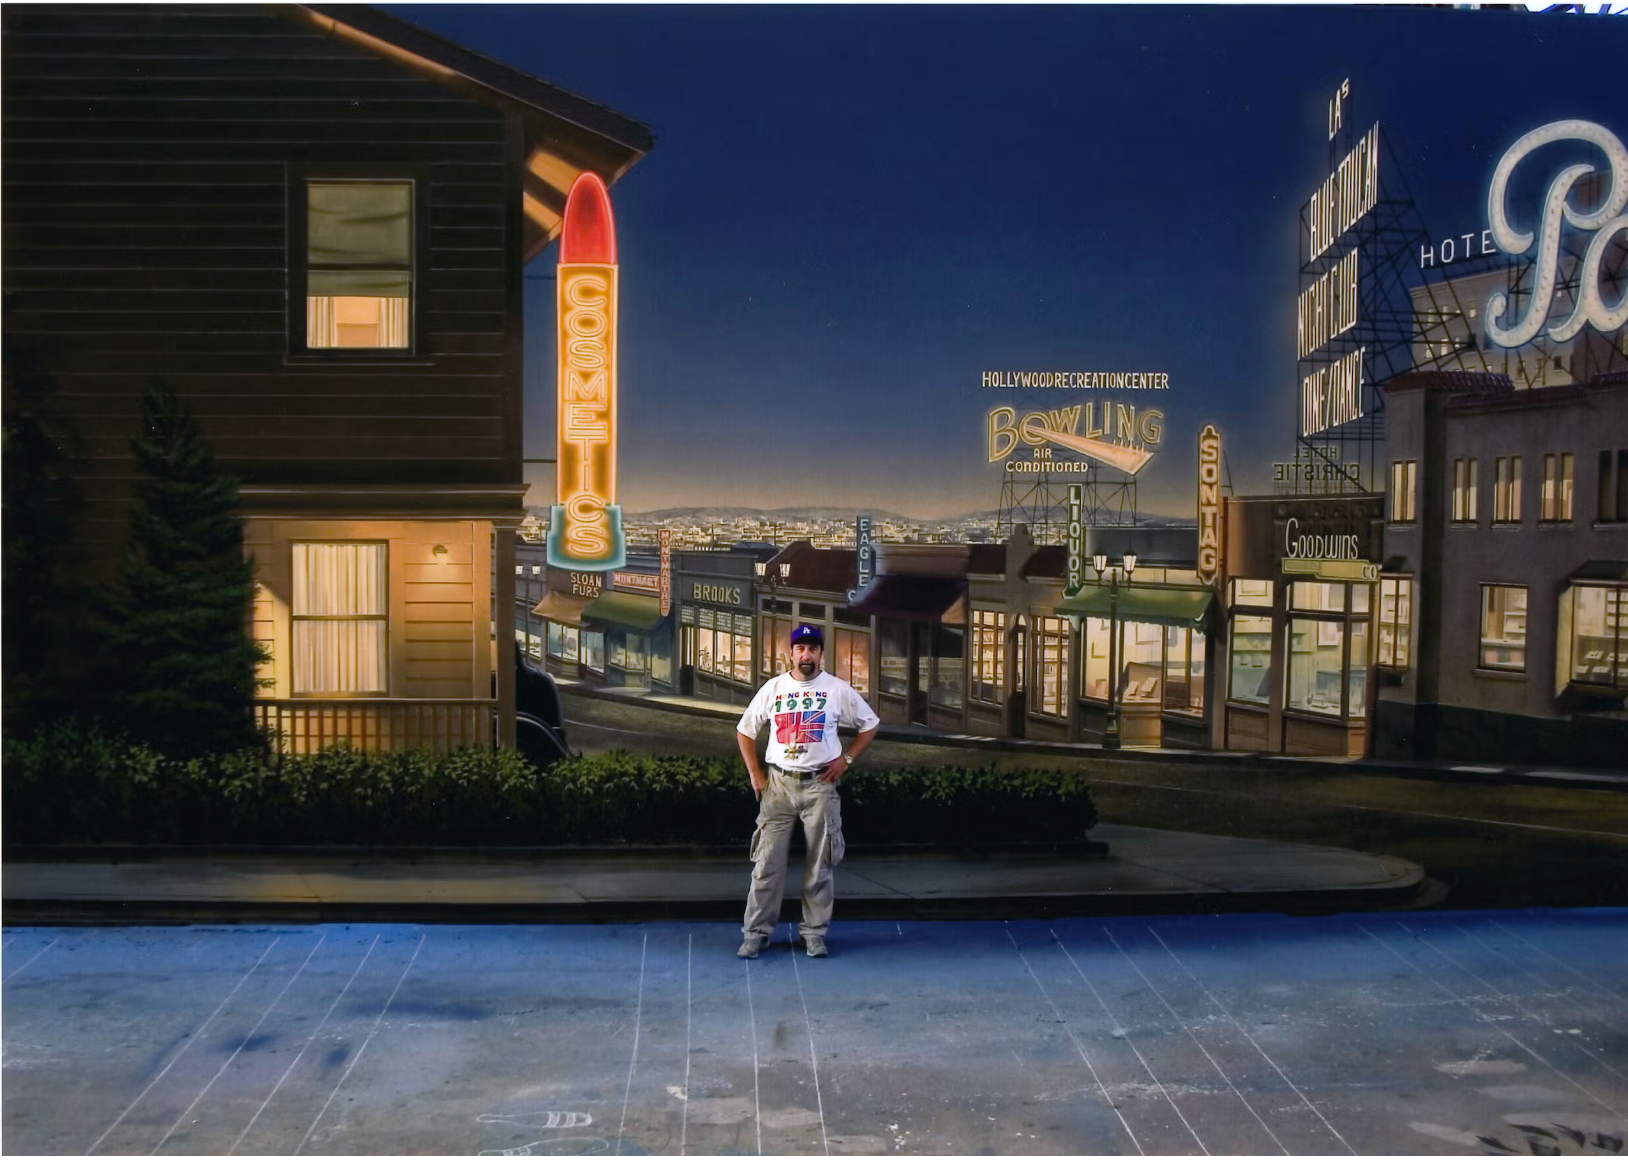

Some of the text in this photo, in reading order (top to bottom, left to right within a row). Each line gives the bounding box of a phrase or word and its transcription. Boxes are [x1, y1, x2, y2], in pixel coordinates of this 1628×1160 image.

[1310, 120, 1380, 263] BLUE TOUCAN
[1297, 246, 1359, 362] NIGHT CLUB
[569, 278, 607, 554] COSMETICS
[987, 401, 1163, 464] BOWLING
[1032, 447, 1053, 459] AIR
[1200, 437, 1219, 571] SONTAG
[570, 572, 602, 588] SLOAN
[660, 531, 670, 609] MONTMARTRE
[858, 518, 870, 588] EAGLE
[572, 583, 600, 598] FURS
[693, 582, 741, 605] BROOKS
[774, 697, 827, 713] 1997
[775, 691, 827, 701] HONG KONG
